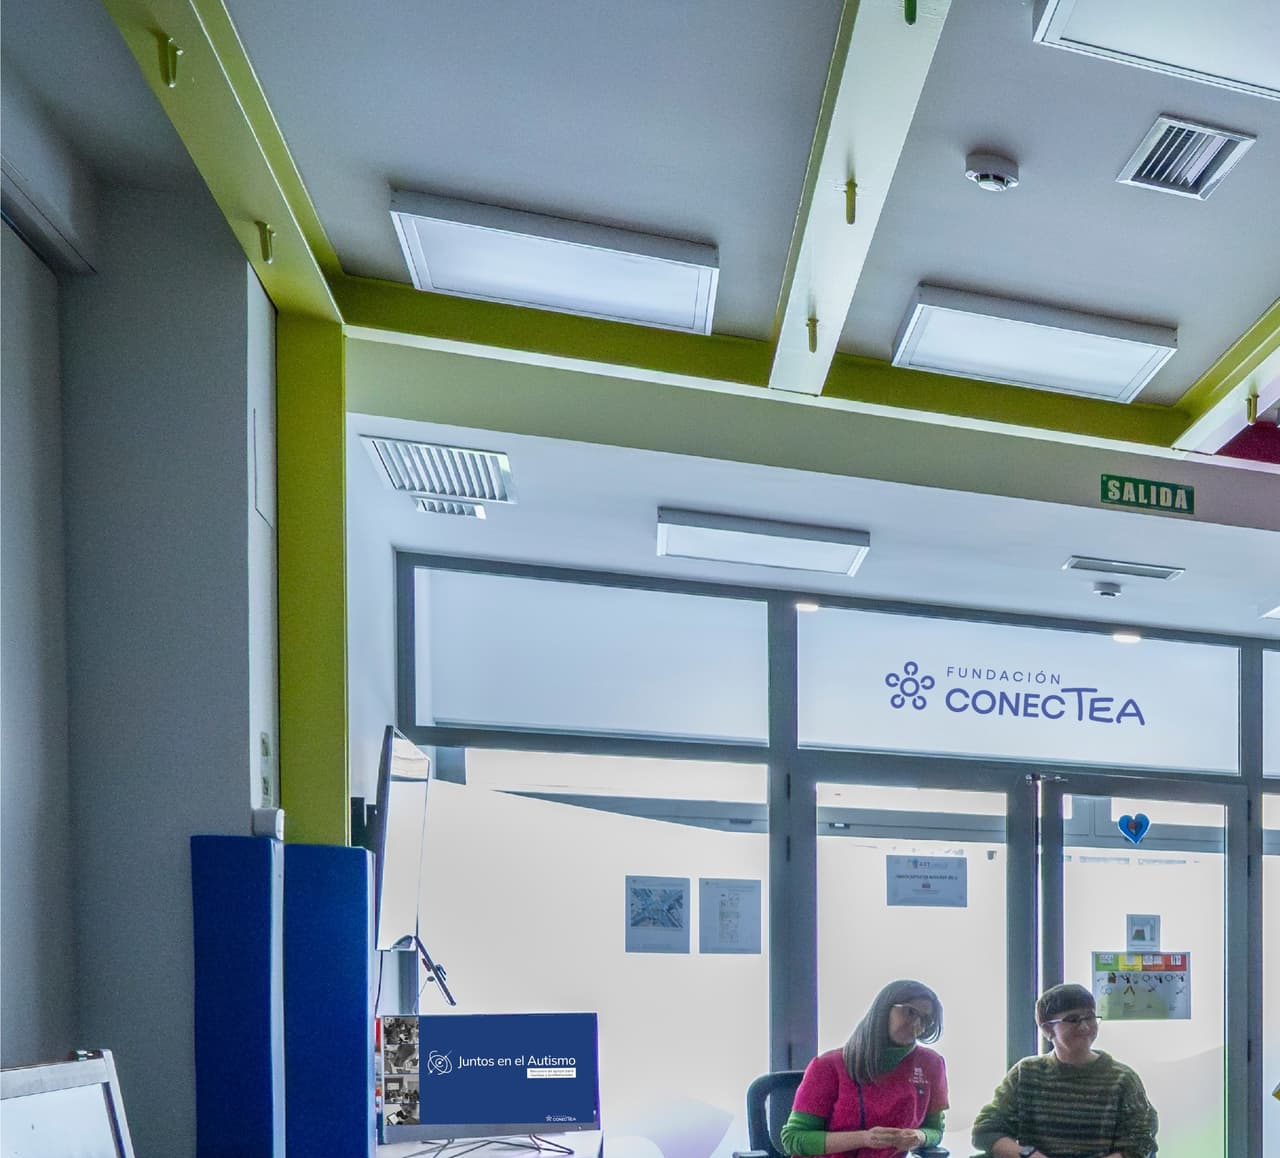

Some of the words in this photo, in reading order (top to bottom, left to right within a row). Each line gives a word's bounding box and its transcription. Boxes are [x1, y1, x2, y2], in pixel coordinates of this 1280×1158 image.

[1107, 479, 1188, 510] SALIDA
[946, 666, 1062, 685] FUNDACIÓN
[458, 1056, 495, 1069] Juntos
[497, 1057, 512, 1067] en
[514, 1055, 525, 1067] el
[527, 1055, 576, 1066] Autismo
